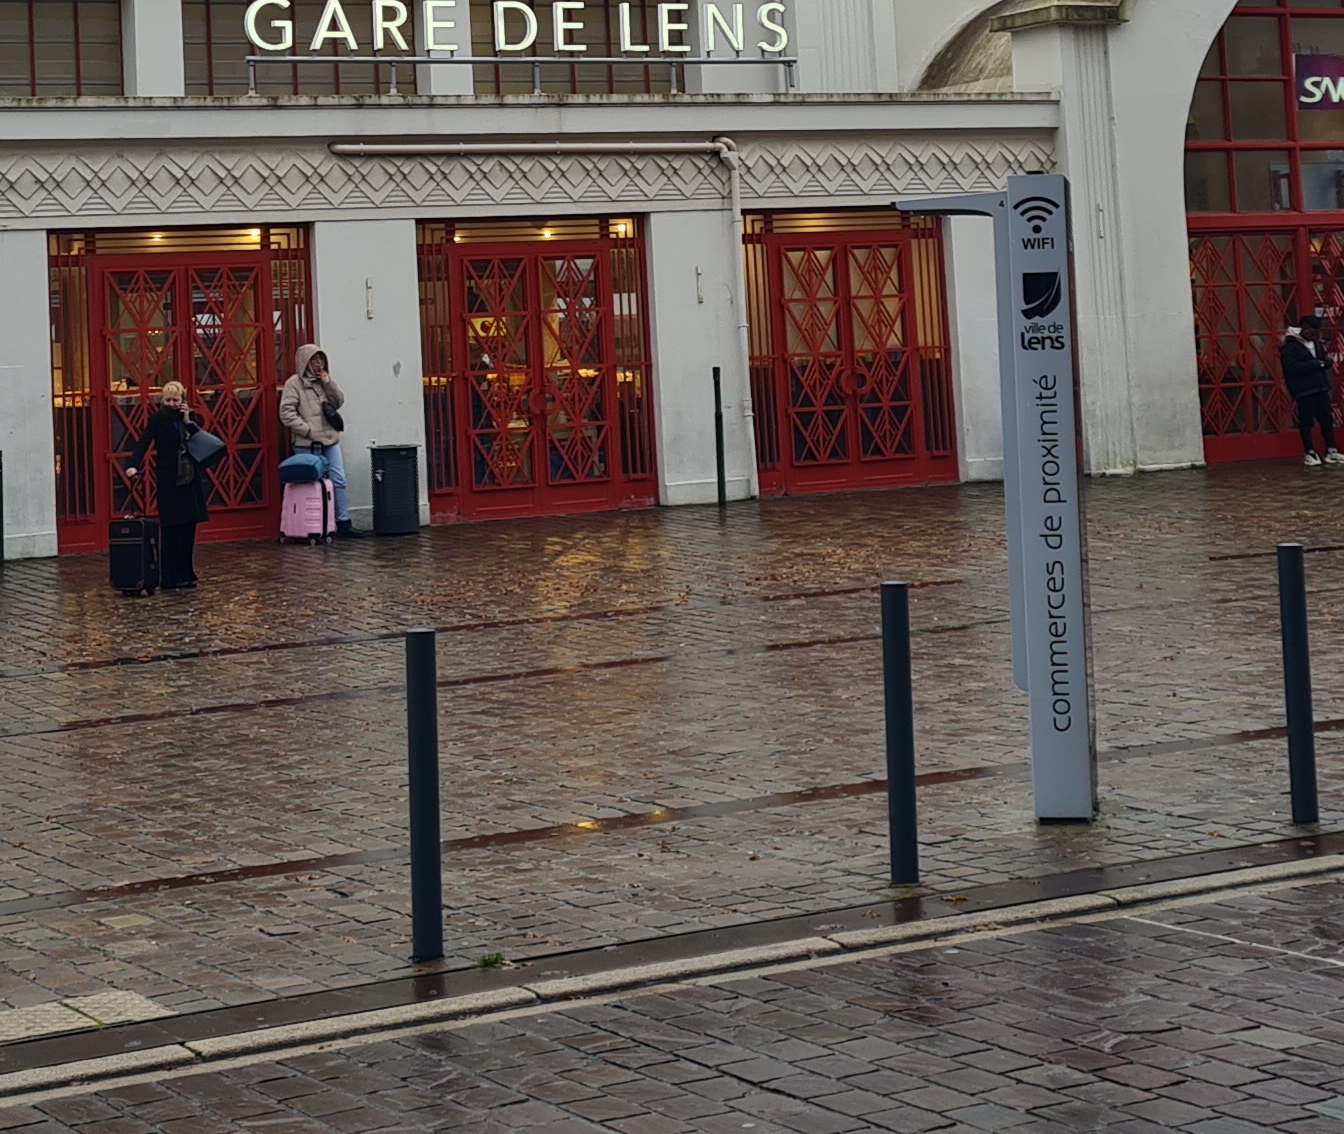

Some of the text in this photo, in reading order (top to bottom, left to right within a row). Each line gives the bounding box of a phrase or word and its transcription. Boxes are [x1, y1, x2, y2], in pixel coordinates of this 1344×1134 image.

[495, 0, 588, 52] DE
[619, 2, 789, 53] LENS
[1021, 237, 1054, 250] WIFI
[1024, 322, 1064, 334] ville de
[1032, 374, 1072, 732] commerces de proximité
